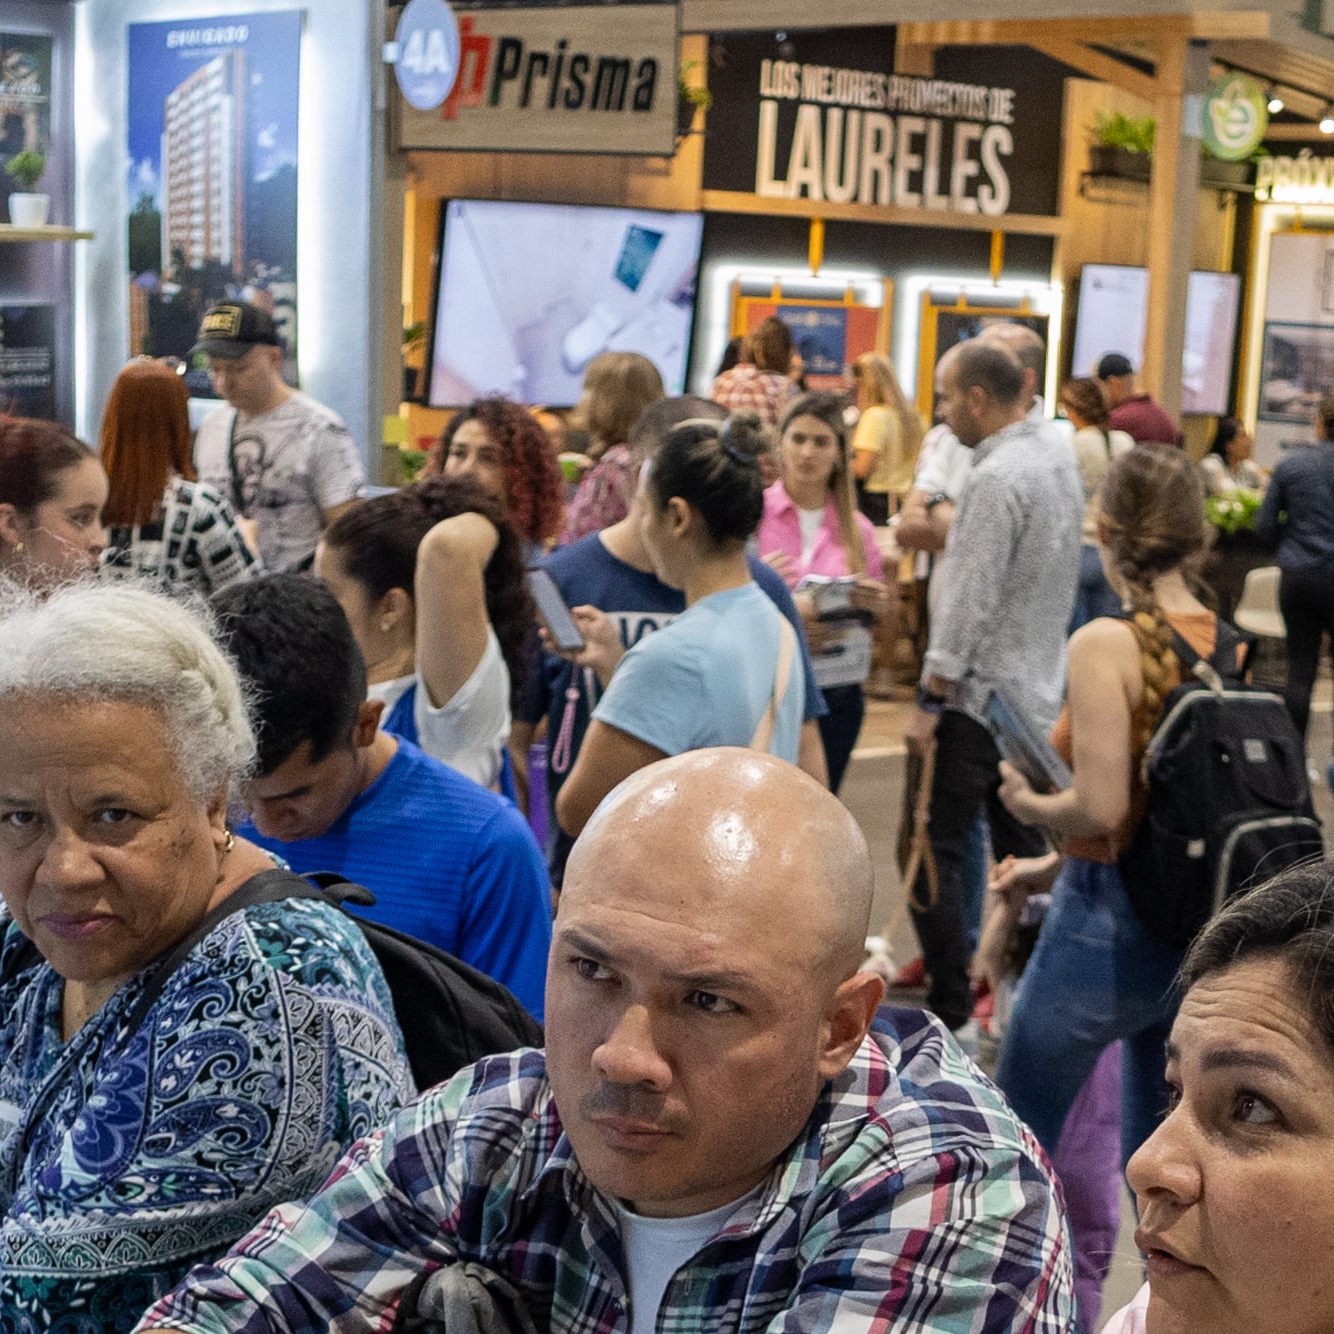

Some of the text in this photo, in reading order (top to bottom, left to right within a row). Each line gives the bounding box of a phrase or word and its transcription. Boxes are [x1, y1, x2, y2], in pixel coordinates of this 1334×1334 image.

[399, 28, 452, 75] 4A
[489, 36, 658, 112] Prisma
[759, 58, 1016, 125] LOS MEJORES PROYECTOS DE
[754, 99, 1014, 217] LAURELES
